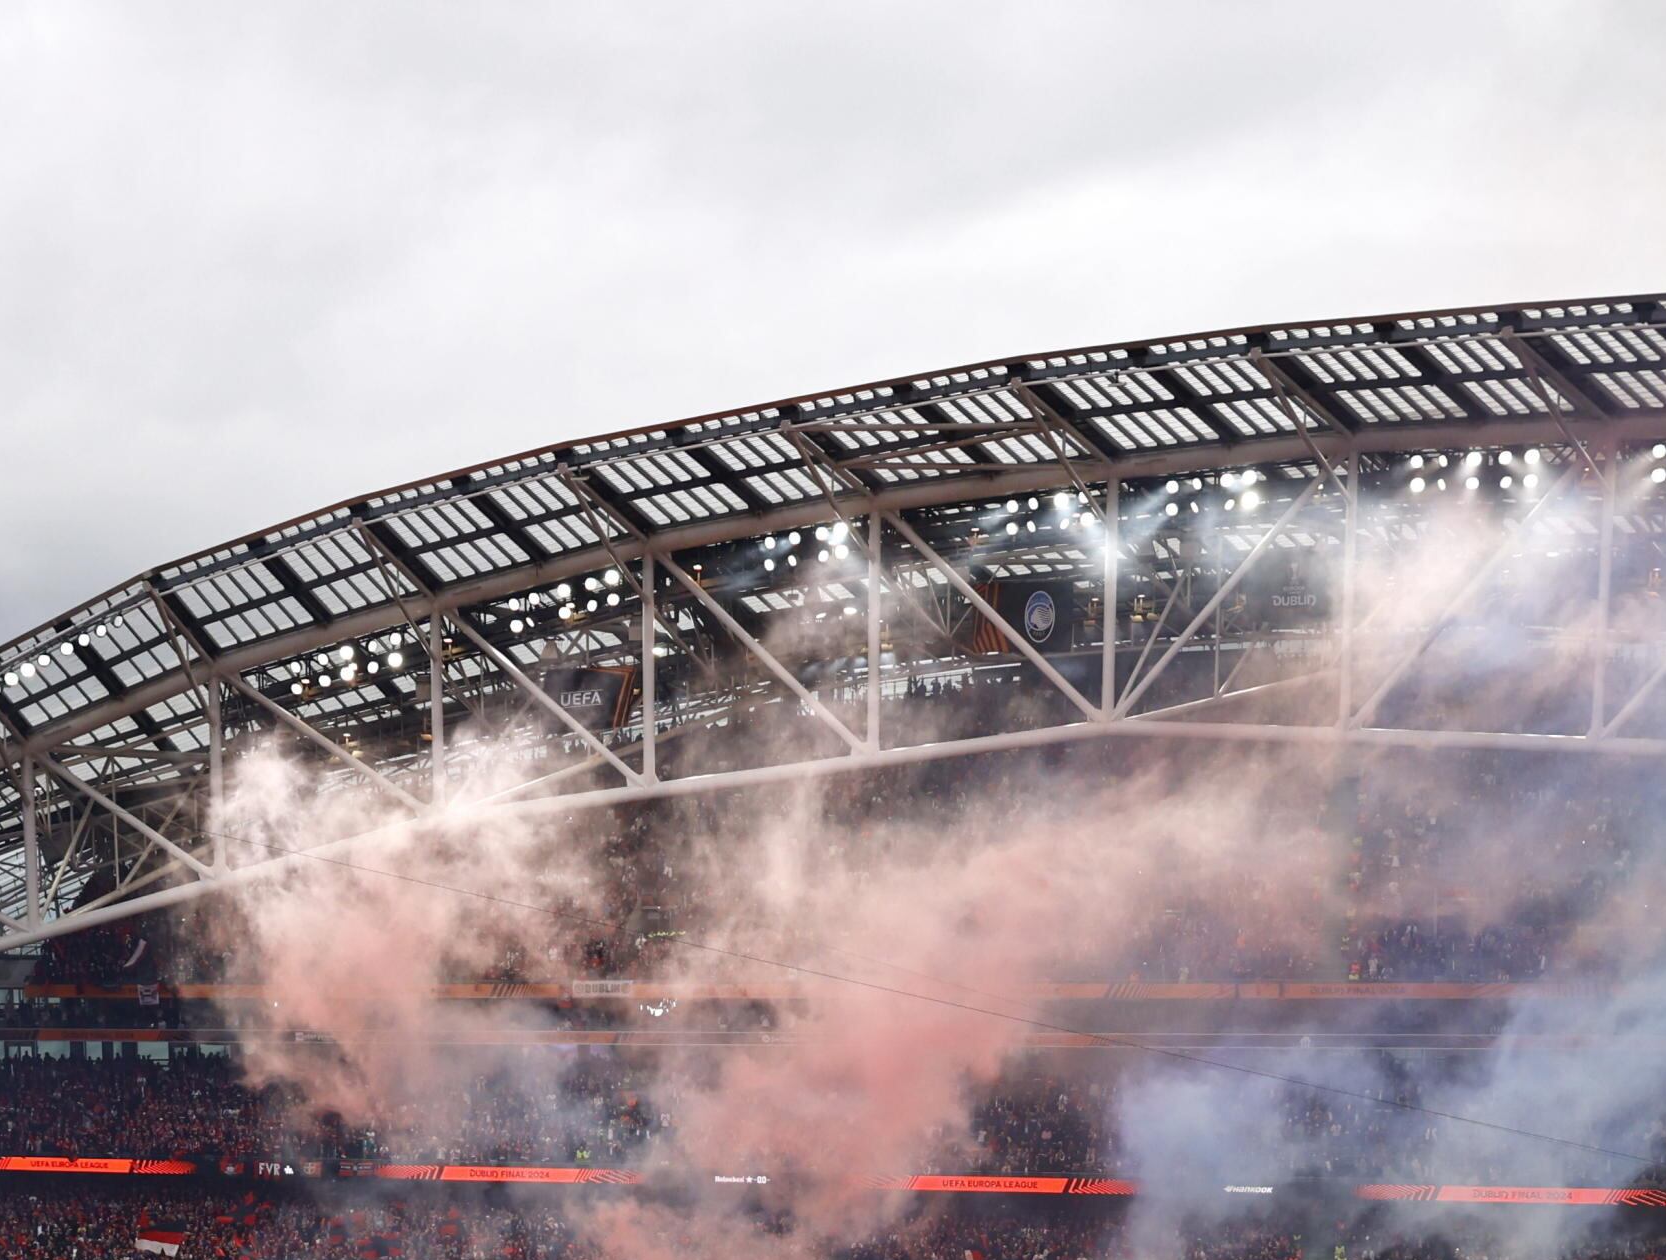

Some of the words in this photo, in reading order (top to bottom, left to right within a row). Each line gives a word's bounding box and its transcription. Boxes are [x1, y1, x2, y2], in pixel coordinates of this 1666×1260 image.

[560, 692, 602, 706] UEFA
[968, 1180, 1002, 1188] EUROPA
[1004, 1181, 1038, 1189] LEAGUE
